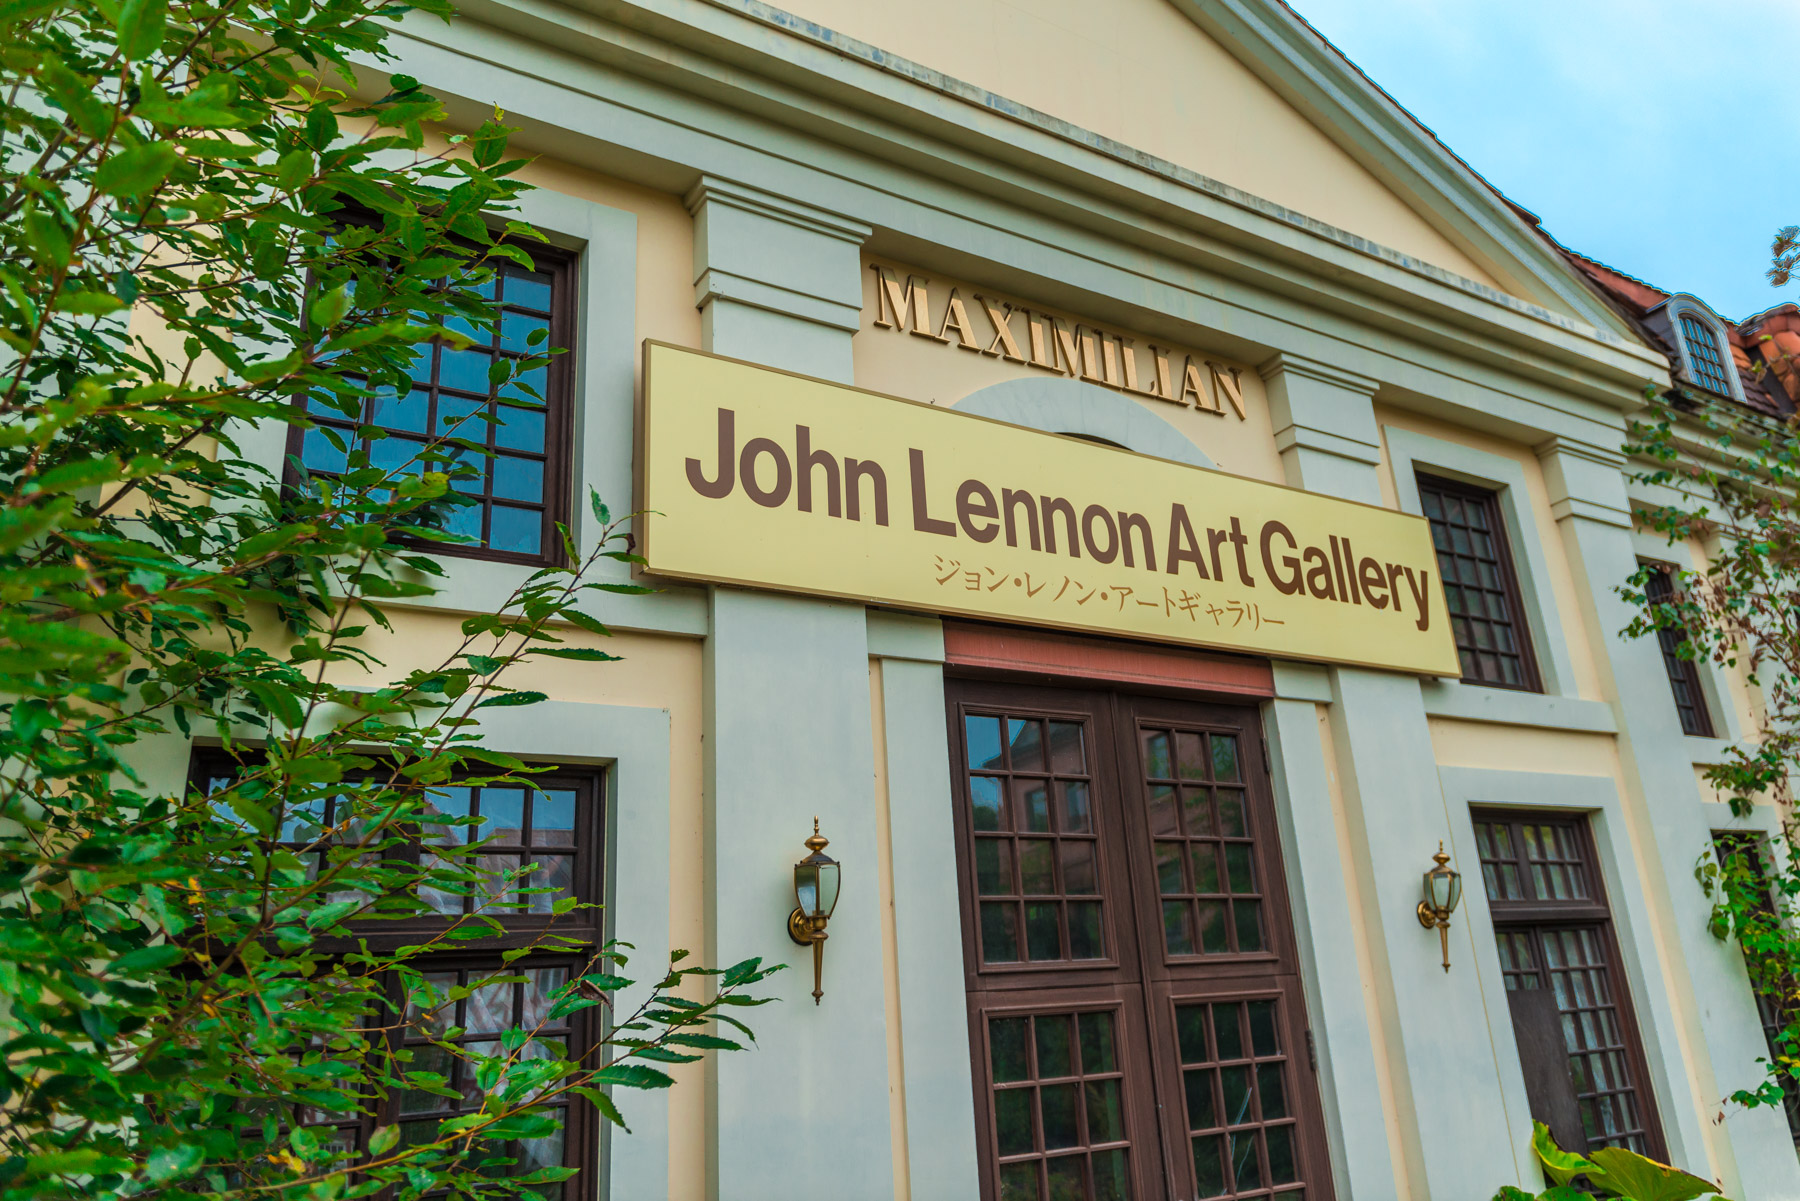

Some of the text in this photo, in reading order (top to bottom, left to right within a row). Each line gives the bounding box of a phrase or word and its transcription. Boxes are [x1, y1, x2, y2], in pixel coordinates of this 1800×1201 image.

[870, 263, 1247, 421] MAXIMILIAN
[685, 407, 1429, 633] John Lennon Art Gallery
